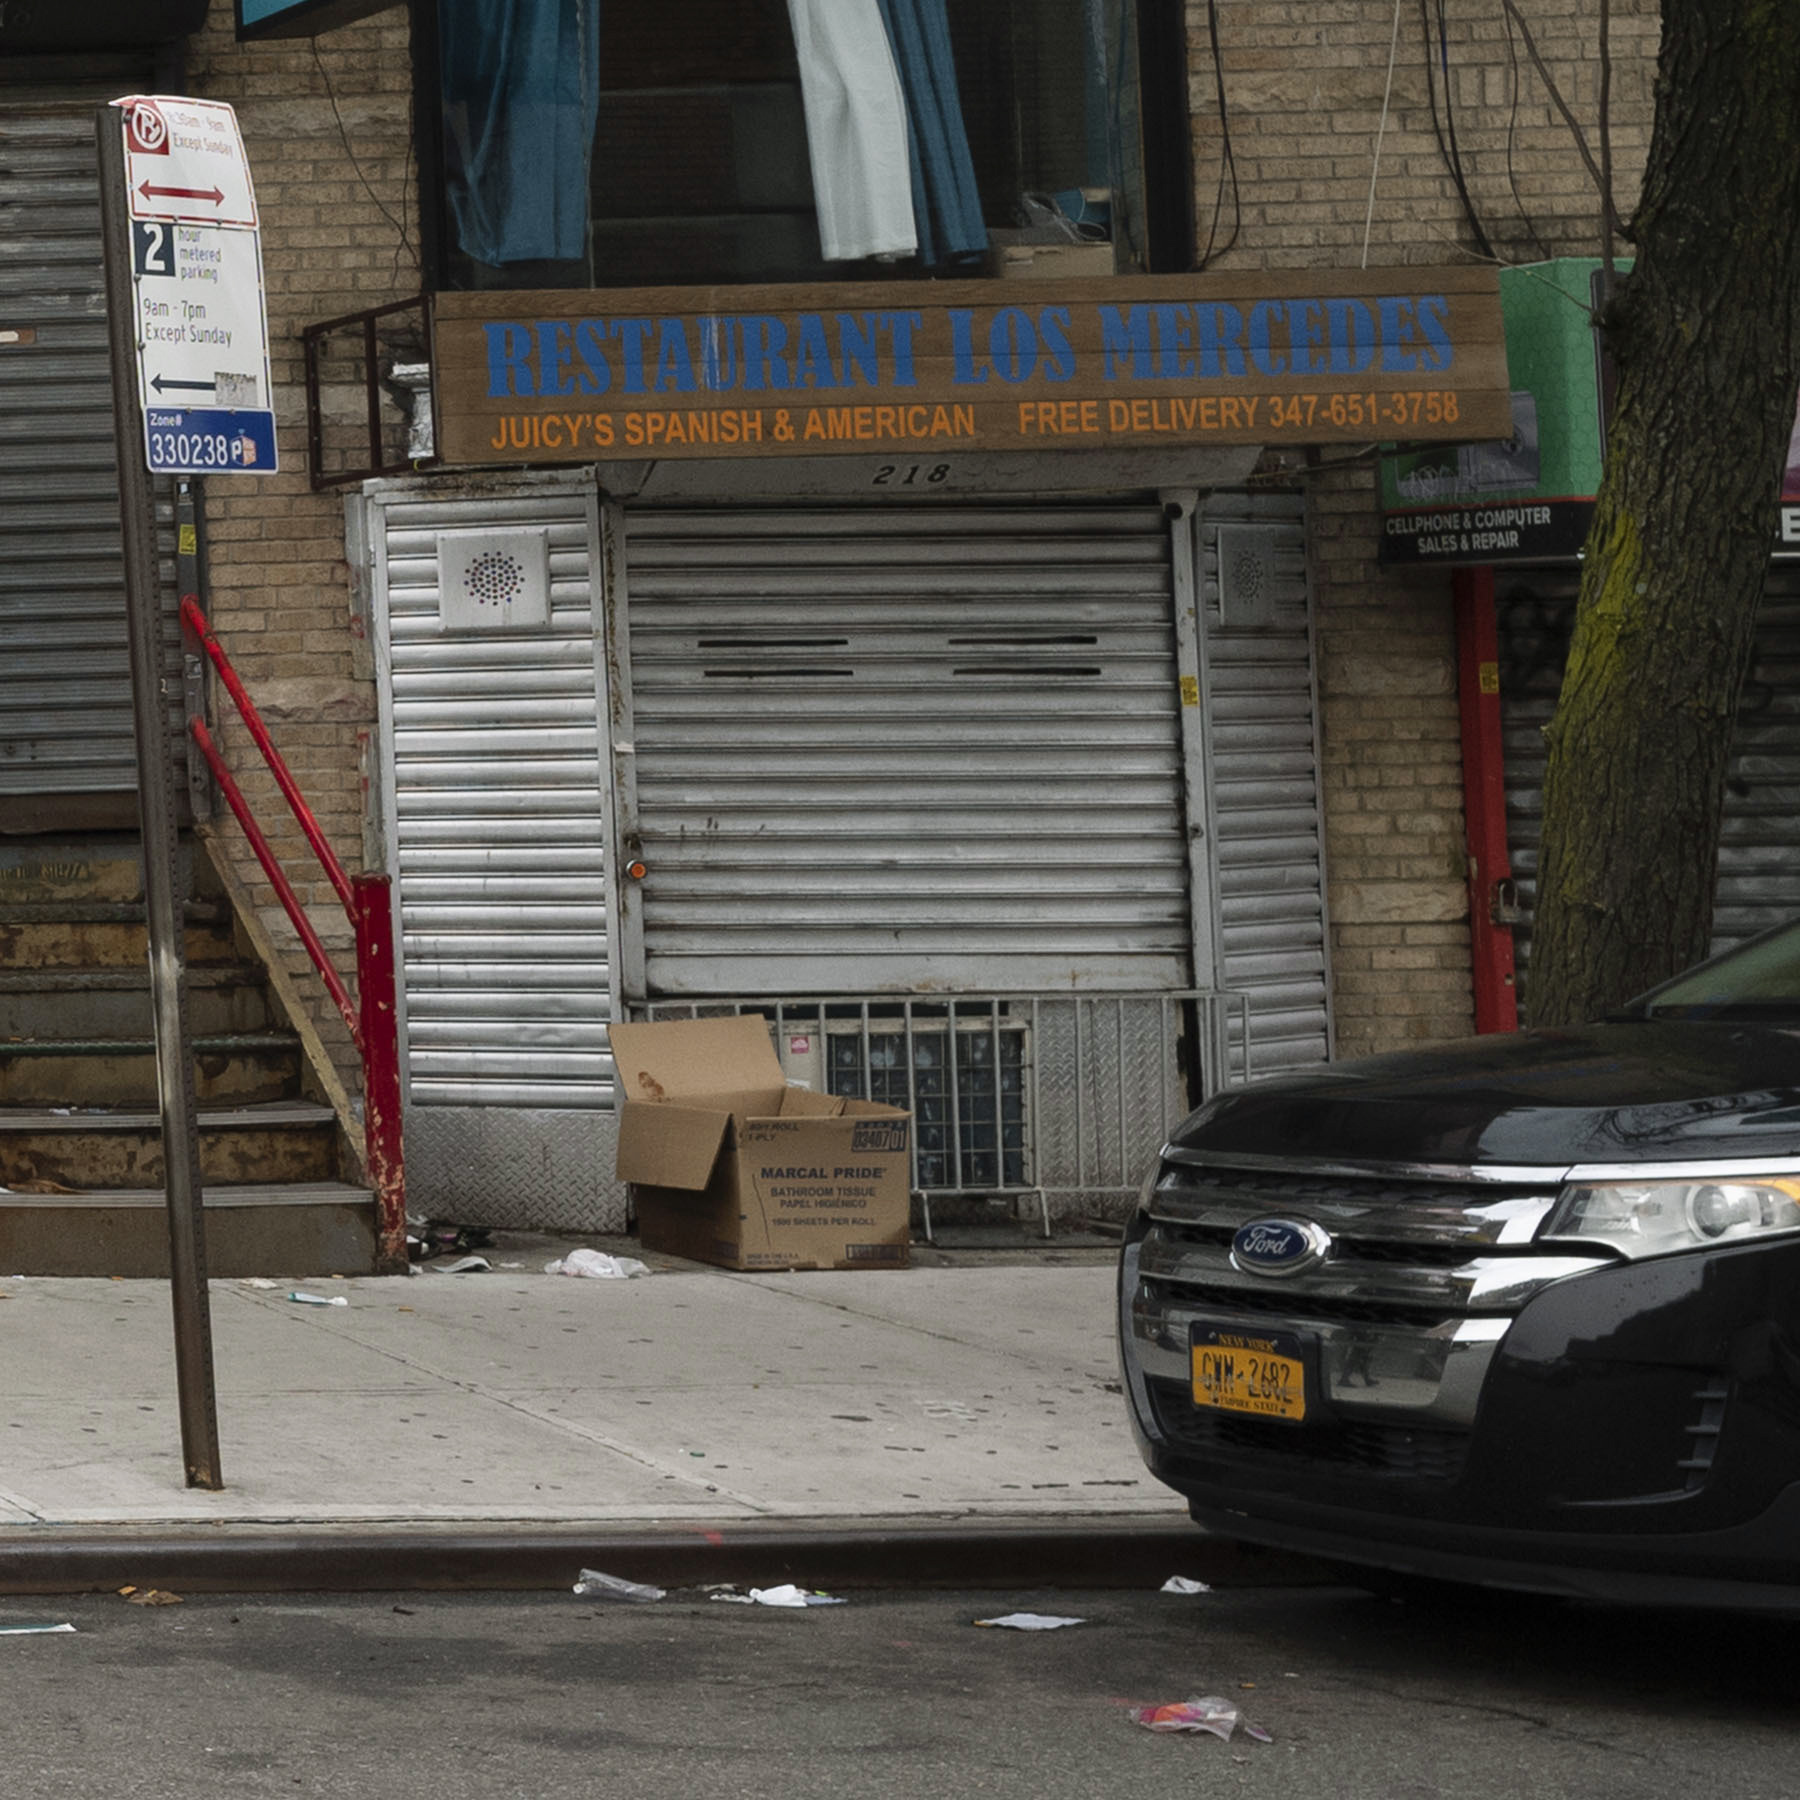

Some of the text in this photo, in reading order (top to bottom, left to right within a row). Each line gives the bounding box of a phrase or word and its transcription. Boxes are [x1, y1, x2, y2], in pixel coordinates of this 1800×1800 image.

[173, 132, 234, 159] Except Sunday
[178, 227, 201, 243] hour
[144, 223, 165, 271] 2
[179, 245, 222, 263] metered
[180, 264, 218, 284] parking
[143, 297, 206, 321] 9am 7pm
[145, 322, 232, 349] Except Sunday
[482, 295, 1454, 399] RESTAURANT LOS MERCEDES
[491, 391, 1460, 450] JUICY'S SPANISH & AMERICAN FREE DELIVERY 347-651-3758
[151, 434, 229, 466] 330238
[872, 463, 951, 486] 218
[1386, 506, 1551, 535] CELLPHONE & COMPUTER
[1418, 531, 1519, 554] SALES & REPAIR
[891, 1130, 904, 1148] 01
[760, 1167, 828, 1179] MARCAL
[770, 1186, 876, 1197] BATHROOM TISSUE
[780, 1200, 812, 1209] PAPEL
[1243, 1225, 1288, 1256] Ford
[1219, 1333, 1244, 1348] NEW
